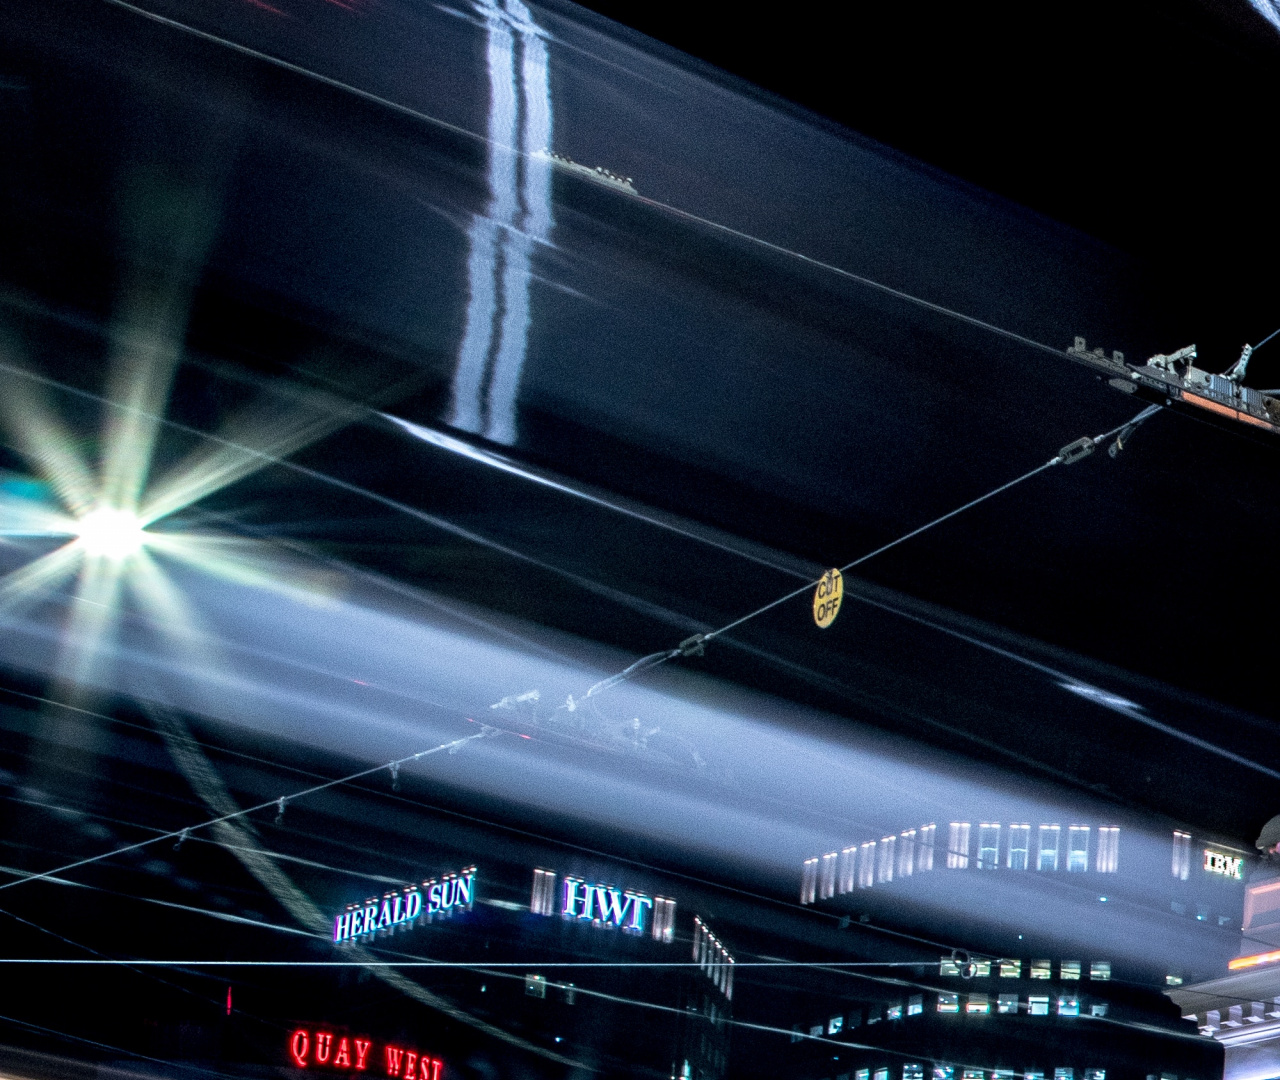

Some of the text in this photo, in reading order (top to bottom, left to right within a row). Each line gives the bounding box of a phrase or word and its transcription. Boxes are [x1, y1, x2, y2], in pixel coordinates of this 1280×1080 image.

[818, 574, 841, 600] CUT
[817, 597, 840, 622] OFF
[1203, 850, 1243, 879] IBM
[334, 874, 475, 943] HERALD SUN
[562, 879, 653, 930] HWT
[291, 1030, 371, 1069] QUAY
